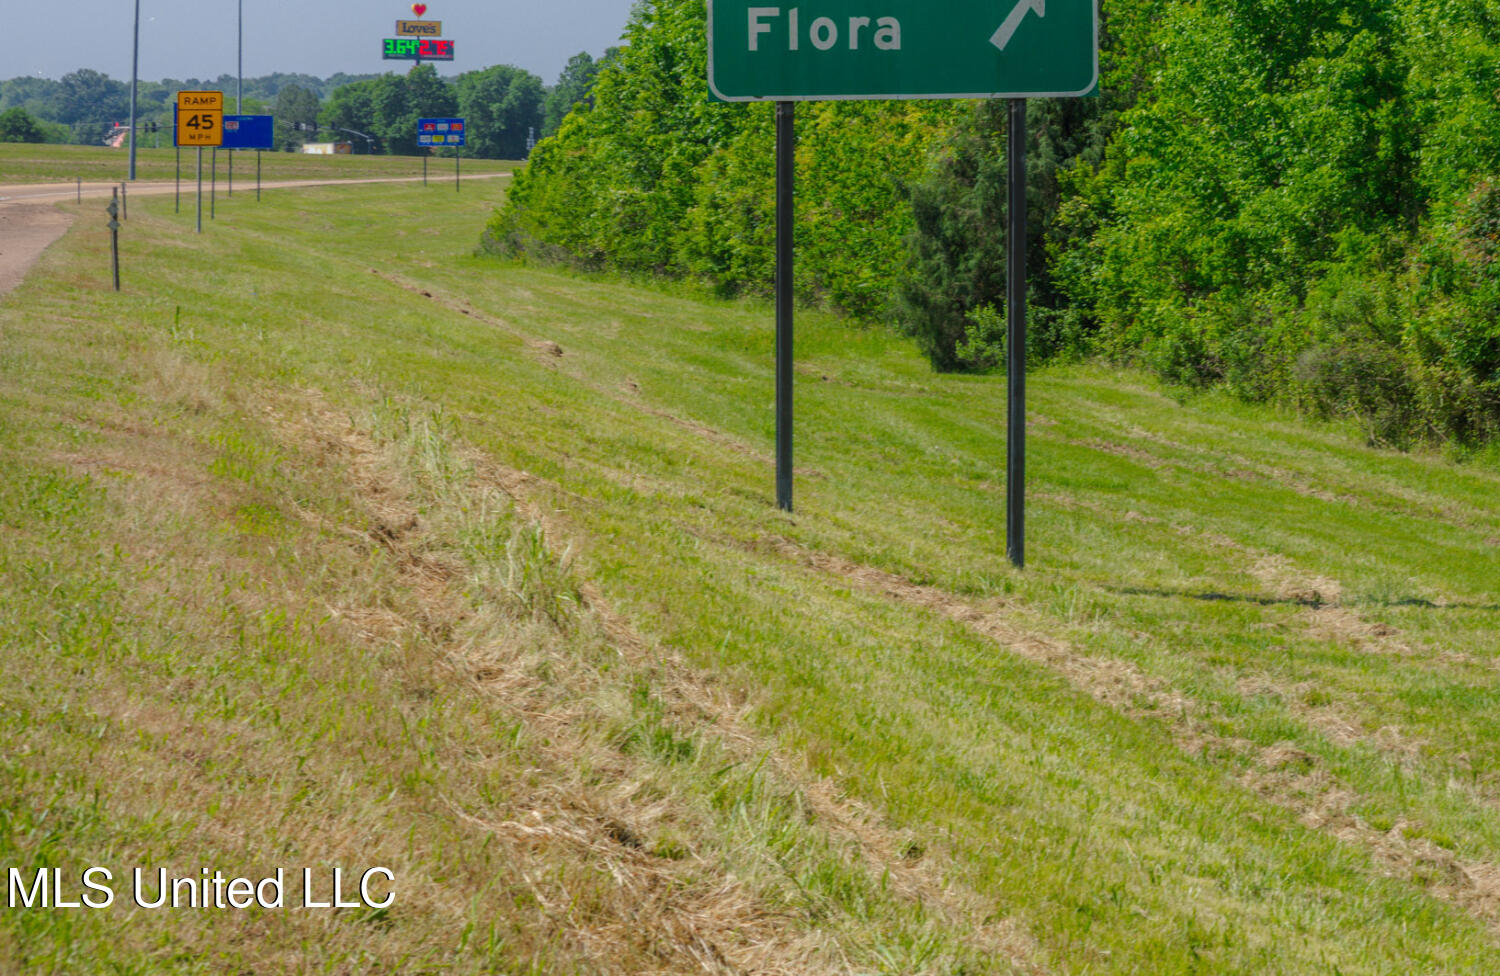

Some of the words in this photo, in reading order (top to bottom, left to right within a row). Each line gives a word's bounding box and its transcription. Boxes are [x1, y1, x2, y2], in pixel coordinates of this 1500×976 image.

[402, 22, 437, 34] Love's
[747, 7, 902, 51] Flora
[184, 96, 217, 105] RAMP
[186, 114, 214, 130] 45
